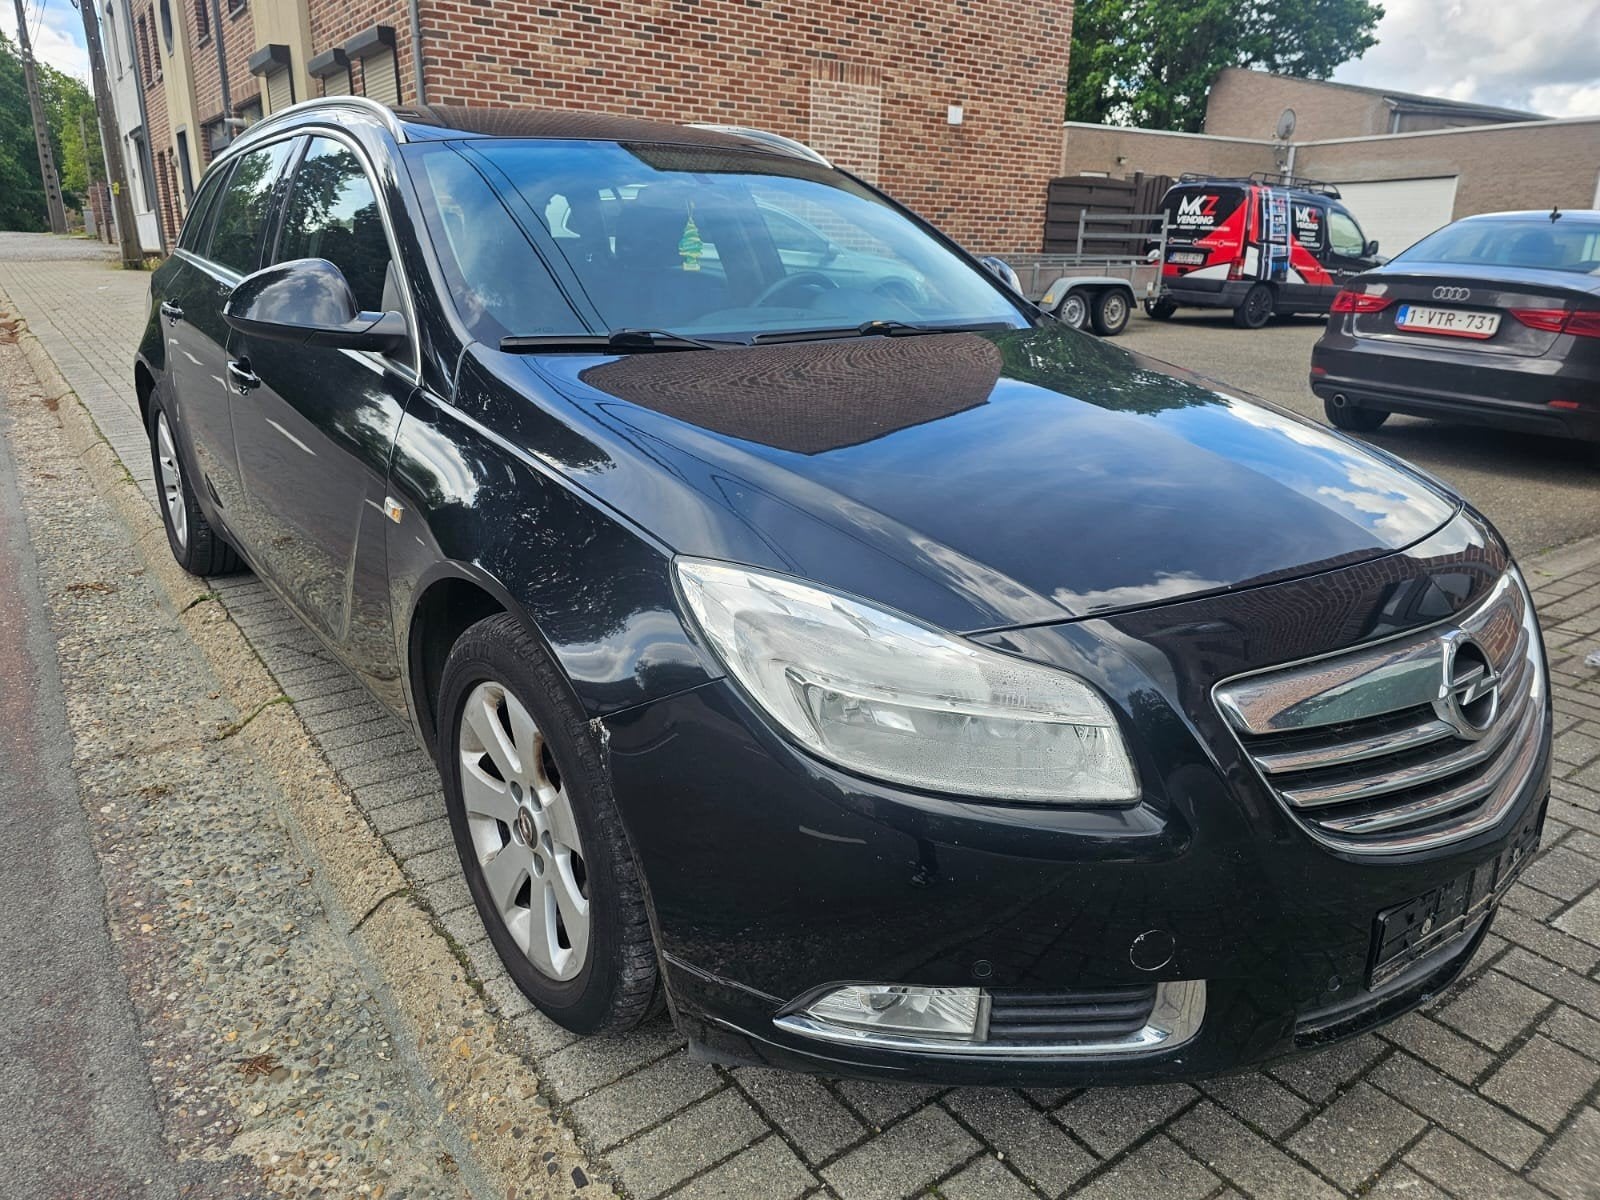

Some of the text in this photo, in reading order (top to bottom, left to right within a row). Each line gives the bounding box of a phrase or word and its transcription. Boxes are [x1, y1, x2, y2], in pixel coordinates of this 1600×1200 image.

[1178, 195, 1220, 215] MKZ
[1177, 215, 1215, 225] VENDING
[1295, 206, 1320, 222] MKZ
